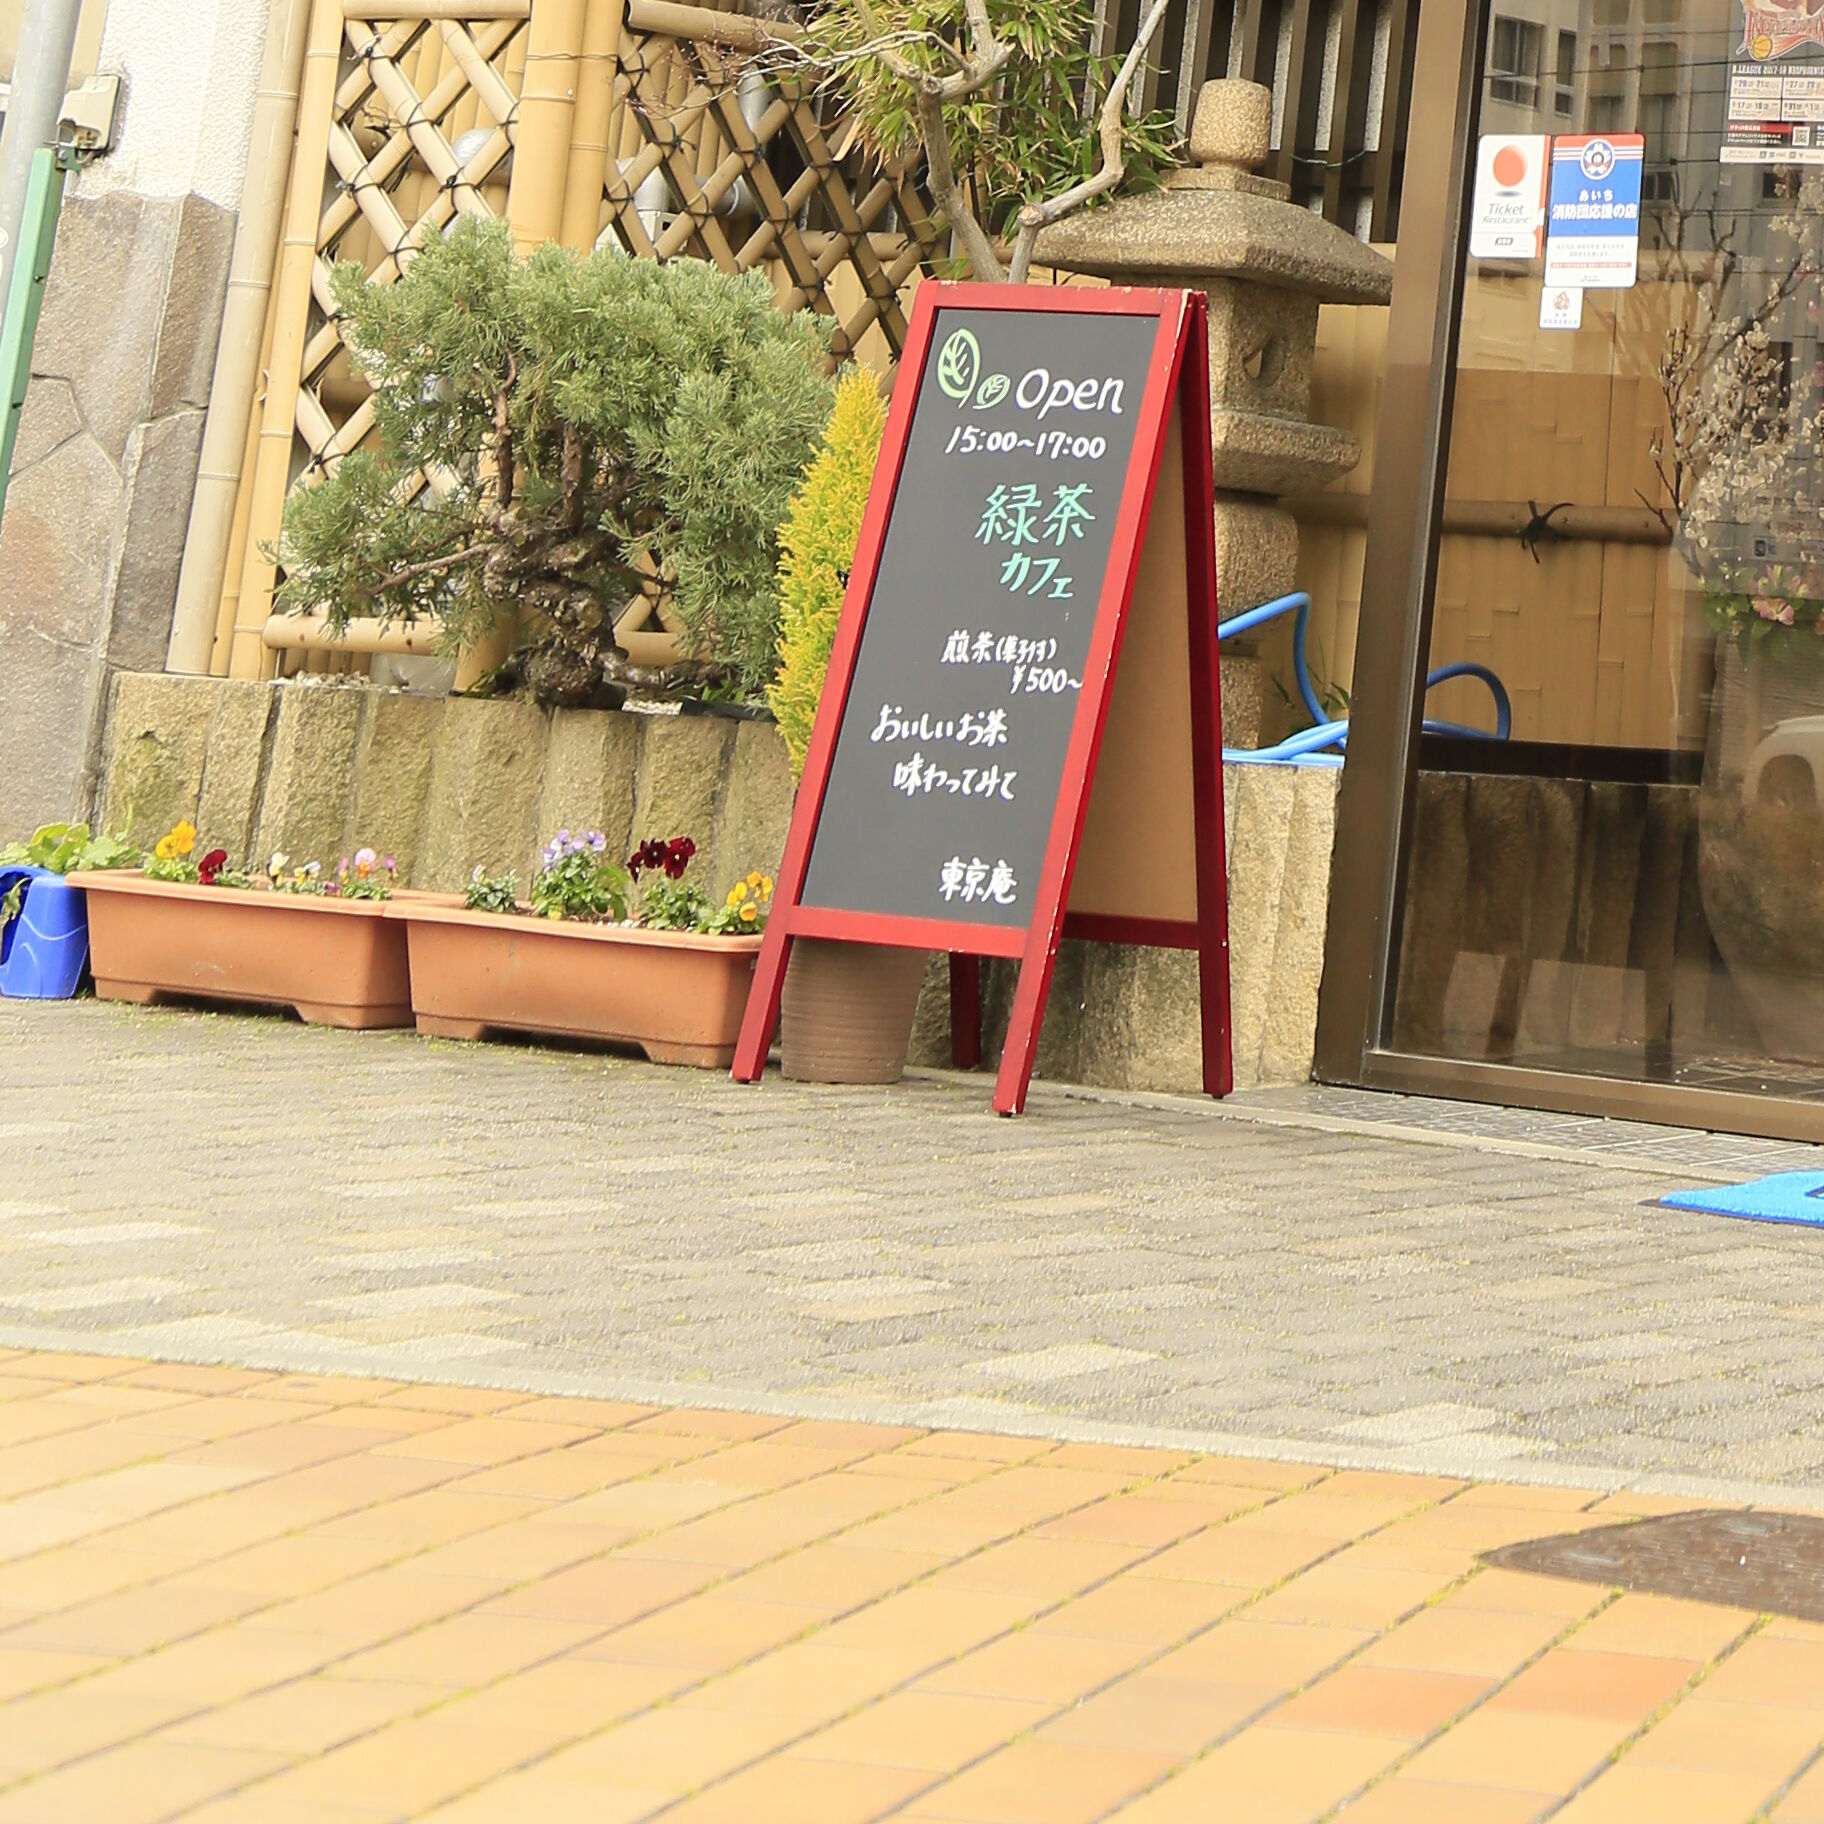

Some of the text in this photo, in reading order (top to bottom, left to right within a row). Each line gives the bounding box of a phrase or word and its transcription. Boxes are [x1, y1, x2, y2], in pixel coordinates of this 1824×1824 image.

[1488, 203, 1525, 216] Ticket
[1552, 204, 1638, 221] 消防団応援の店
[1579, 189, 1613, 201] あいち
[1016, 368, 1125, 420] Open
[975, 483, 1096, 546] 緑茶
[1000, 552, 1074, 598] カフェ
[870, 704, 1008, 747] おいしいお茶
[893, 752, 1017, 800] 味わってみて
[939, 855, 1017, 904] 東京庵
